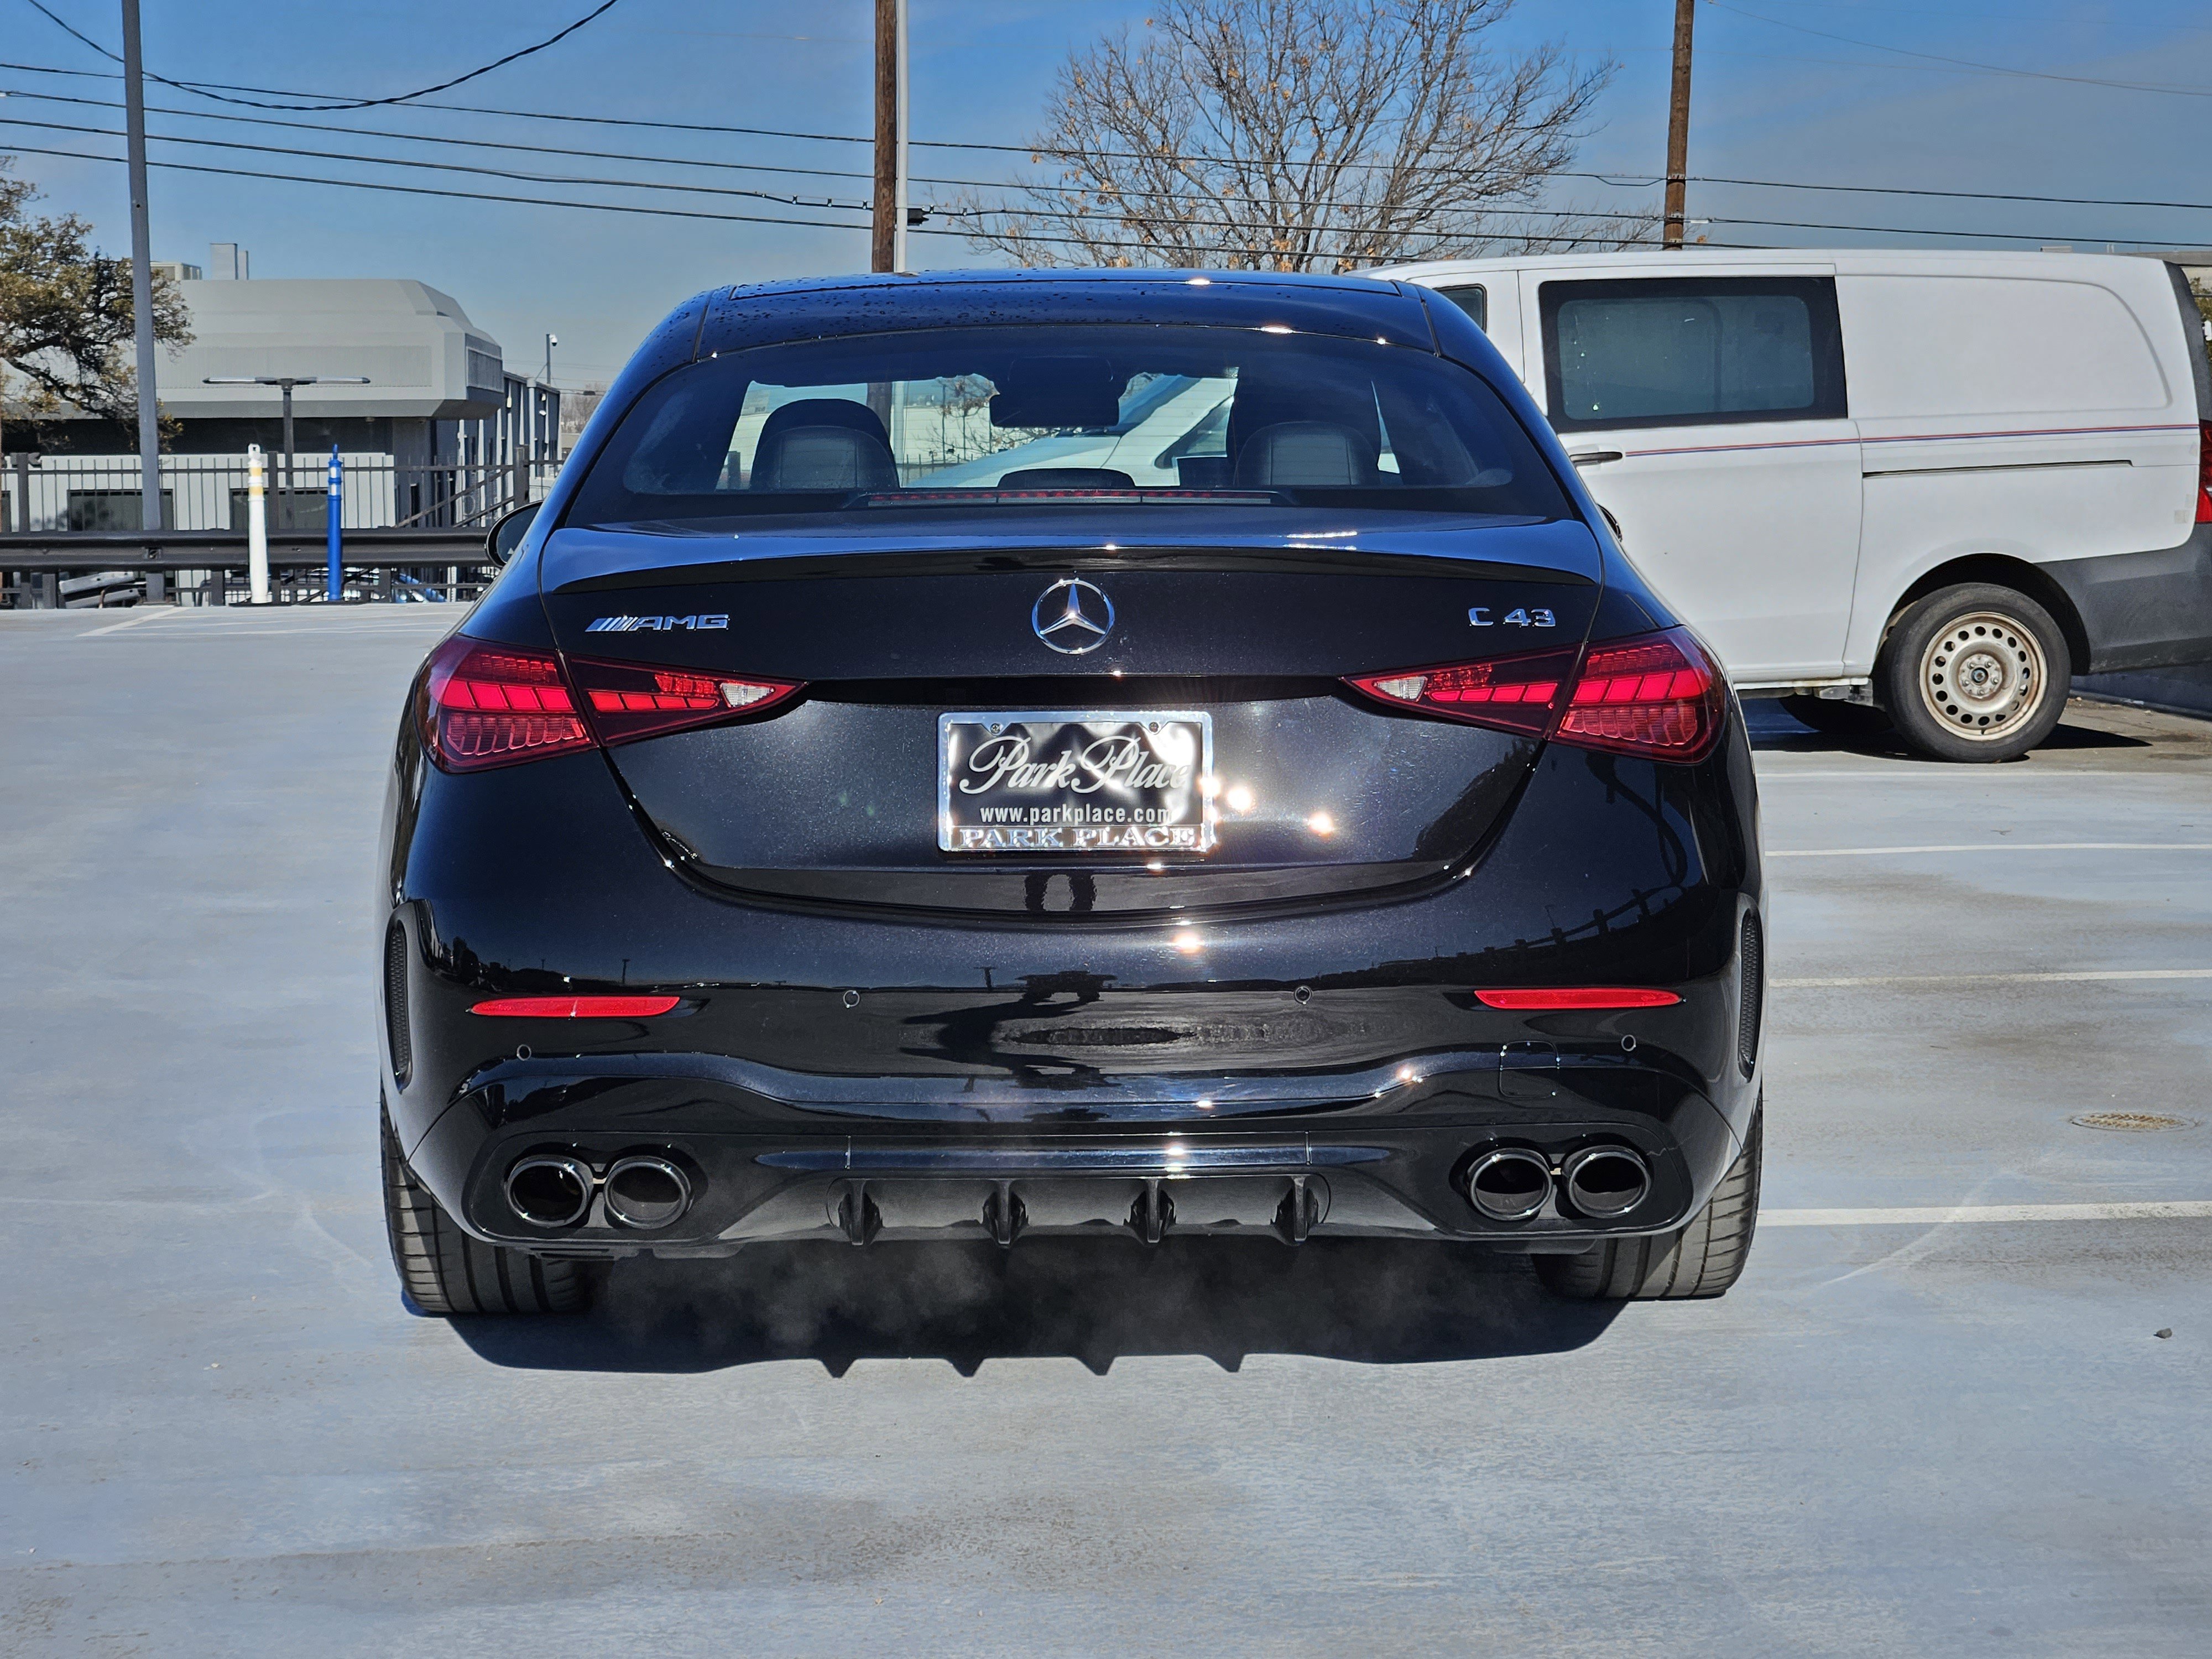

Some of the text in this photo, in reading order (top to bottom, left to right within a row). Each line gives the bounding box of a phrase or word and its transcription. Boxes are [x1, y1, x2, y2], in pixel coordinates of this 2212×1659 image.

[628, 614, 729, 631] AMG
[1468, 607, 1556, 627] C 43
[958, 735, 1190, 794] Park Place
[980, 804, 1172, 826] www.parkplace.com
[959, 827, 1194, 848] PARK PLACE
